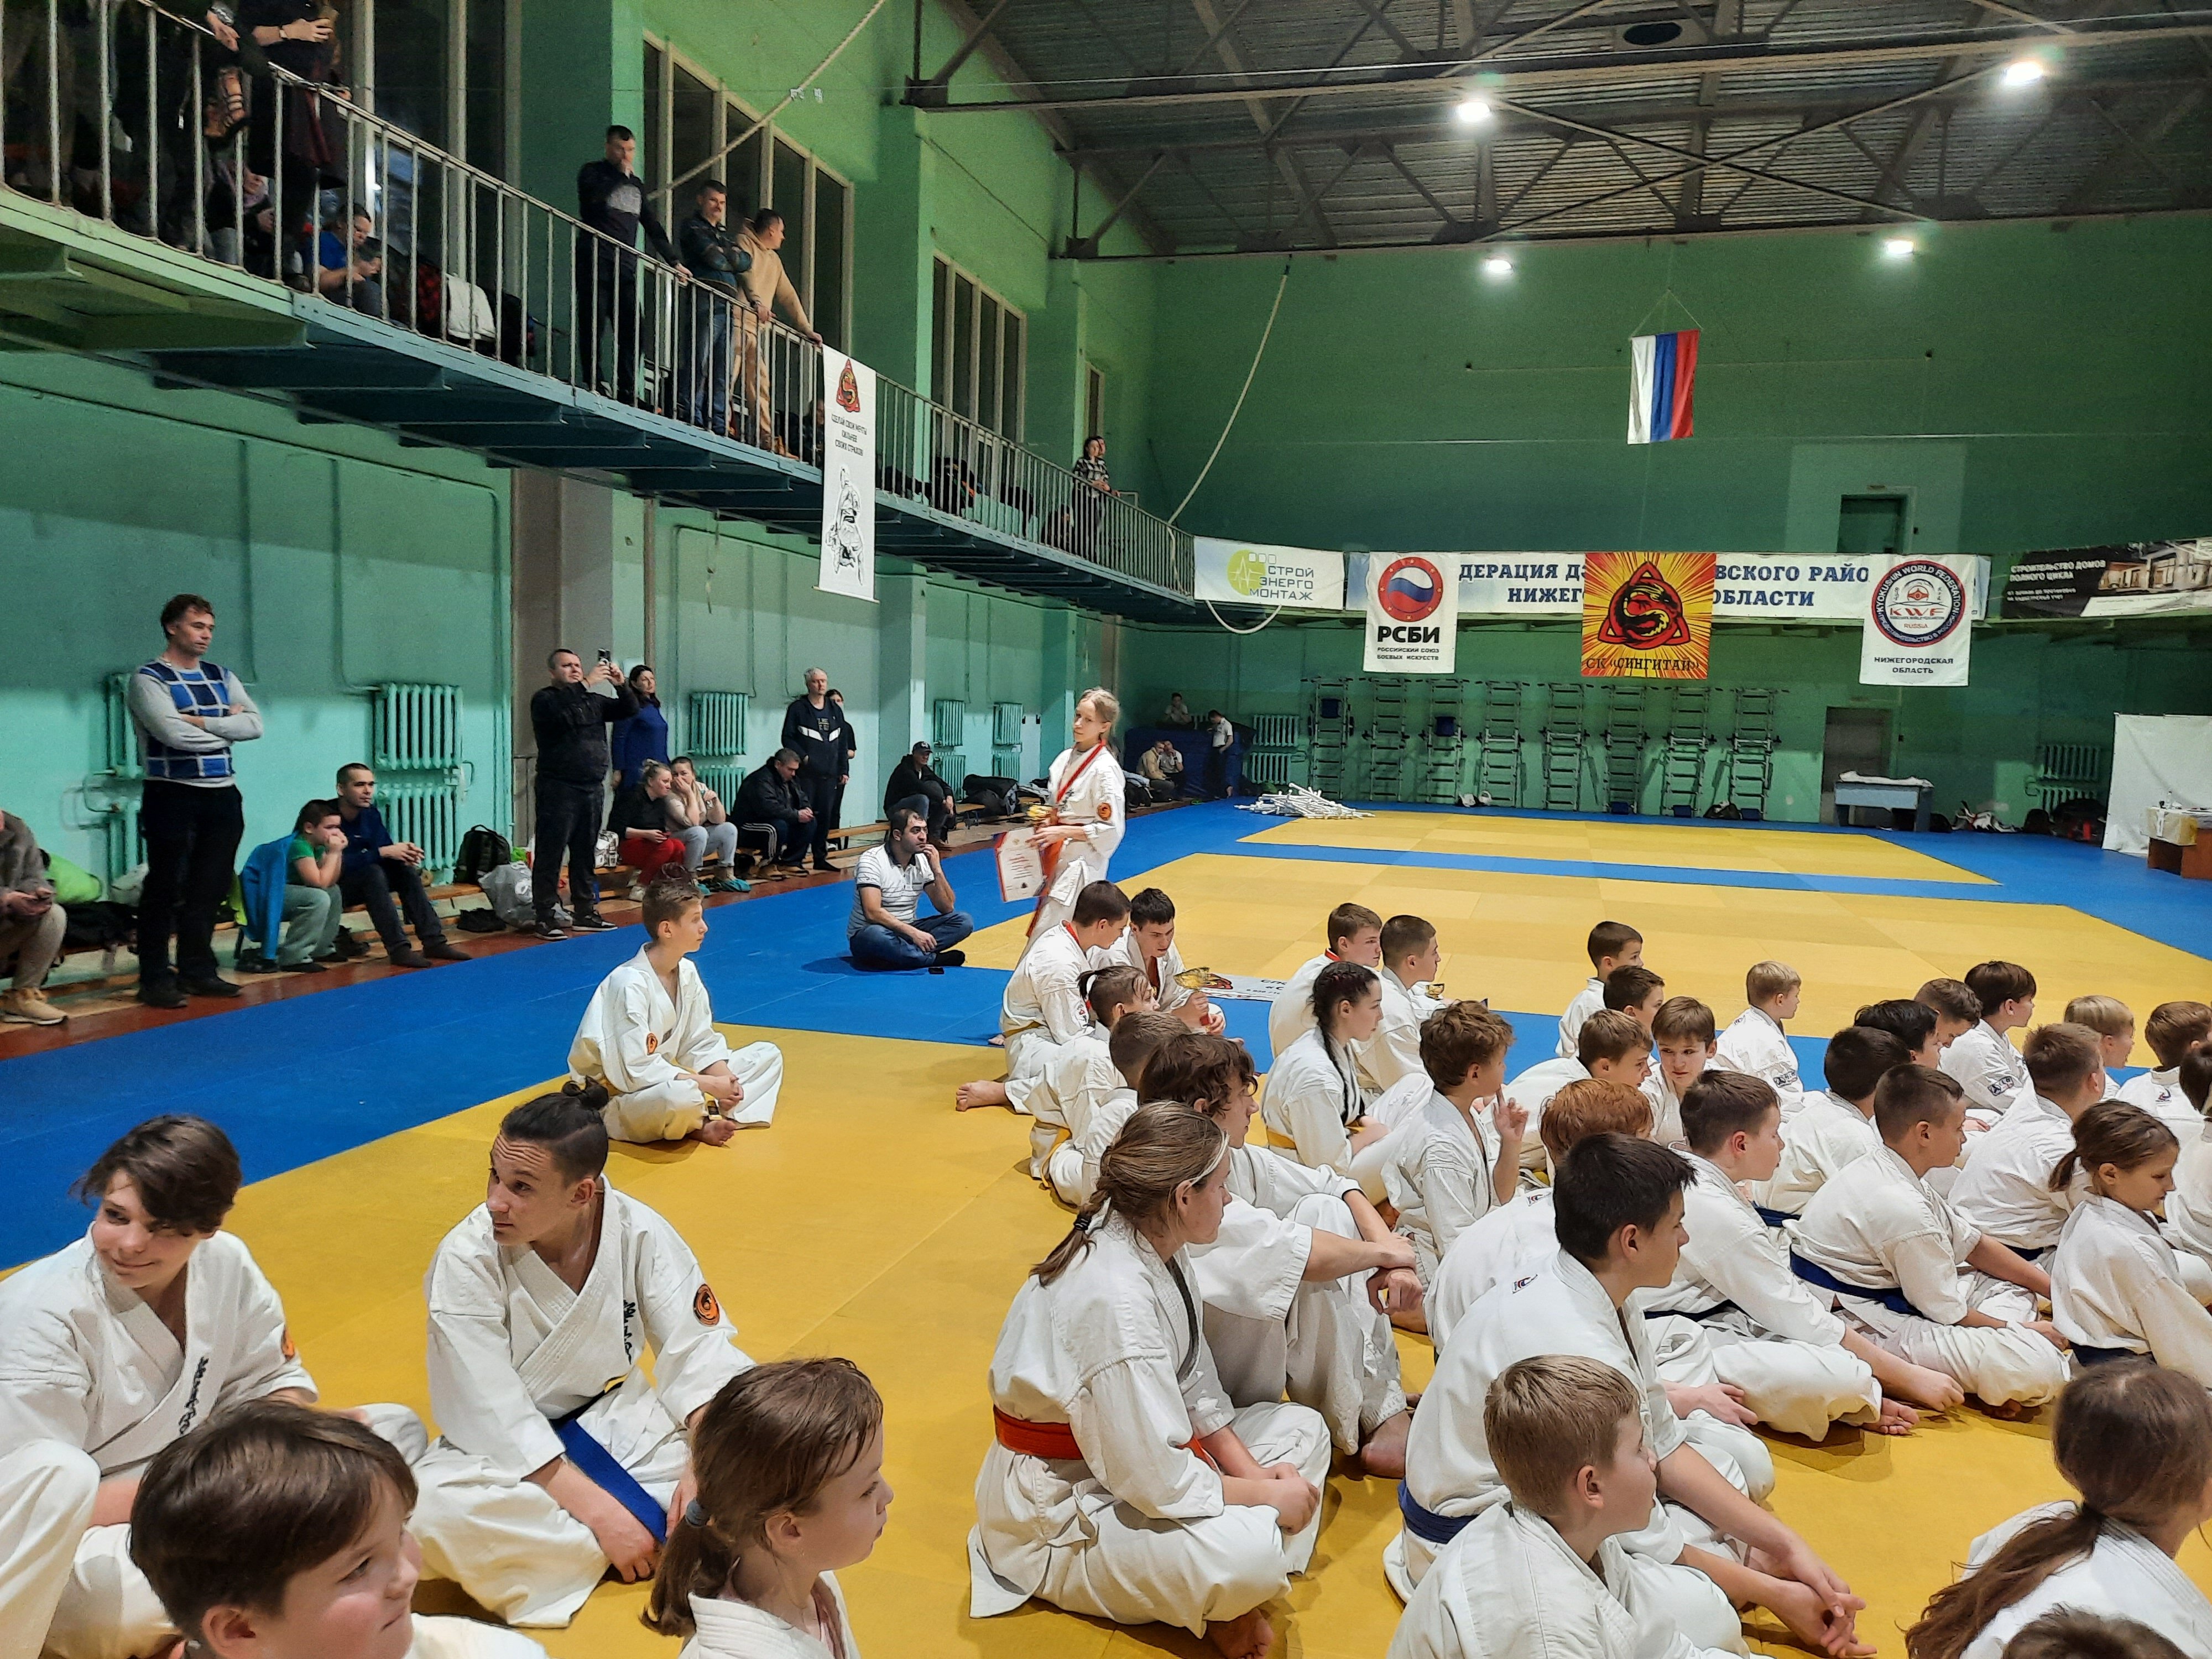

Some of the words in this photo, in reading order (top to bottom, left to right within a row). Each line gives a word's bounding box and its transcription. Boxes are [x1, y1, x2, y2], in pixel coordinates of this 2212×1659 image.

[2075, 560, 2106, 570] ДОМОВ
[1269, 566, 1314, 578] СТРОЙ
[1459, 564, 1558, 581] ДЕРАЦИЯ
[1715, 565, 1799, 581] ВСКОГО
[1808, 563, 1869, 582] РАЙО
[1260, 577, 1313, 589] ЭНЕРГО
[1901, 564, 1935, 575] WORLD
[1935, 568, 1961, 614] FEDERATION
[1250, 588, 1313, 601] МОНТАЖ
[1507, 588, 1584, 602] НИЖЕГ
[1890, 608, 1945, 616] KWF
[1378, 626, 1440, 643] РСБИ
[1586, 658, 1606, 669] СК
[1610, 657, 1699, 671] «СИНГИТАЙ»
